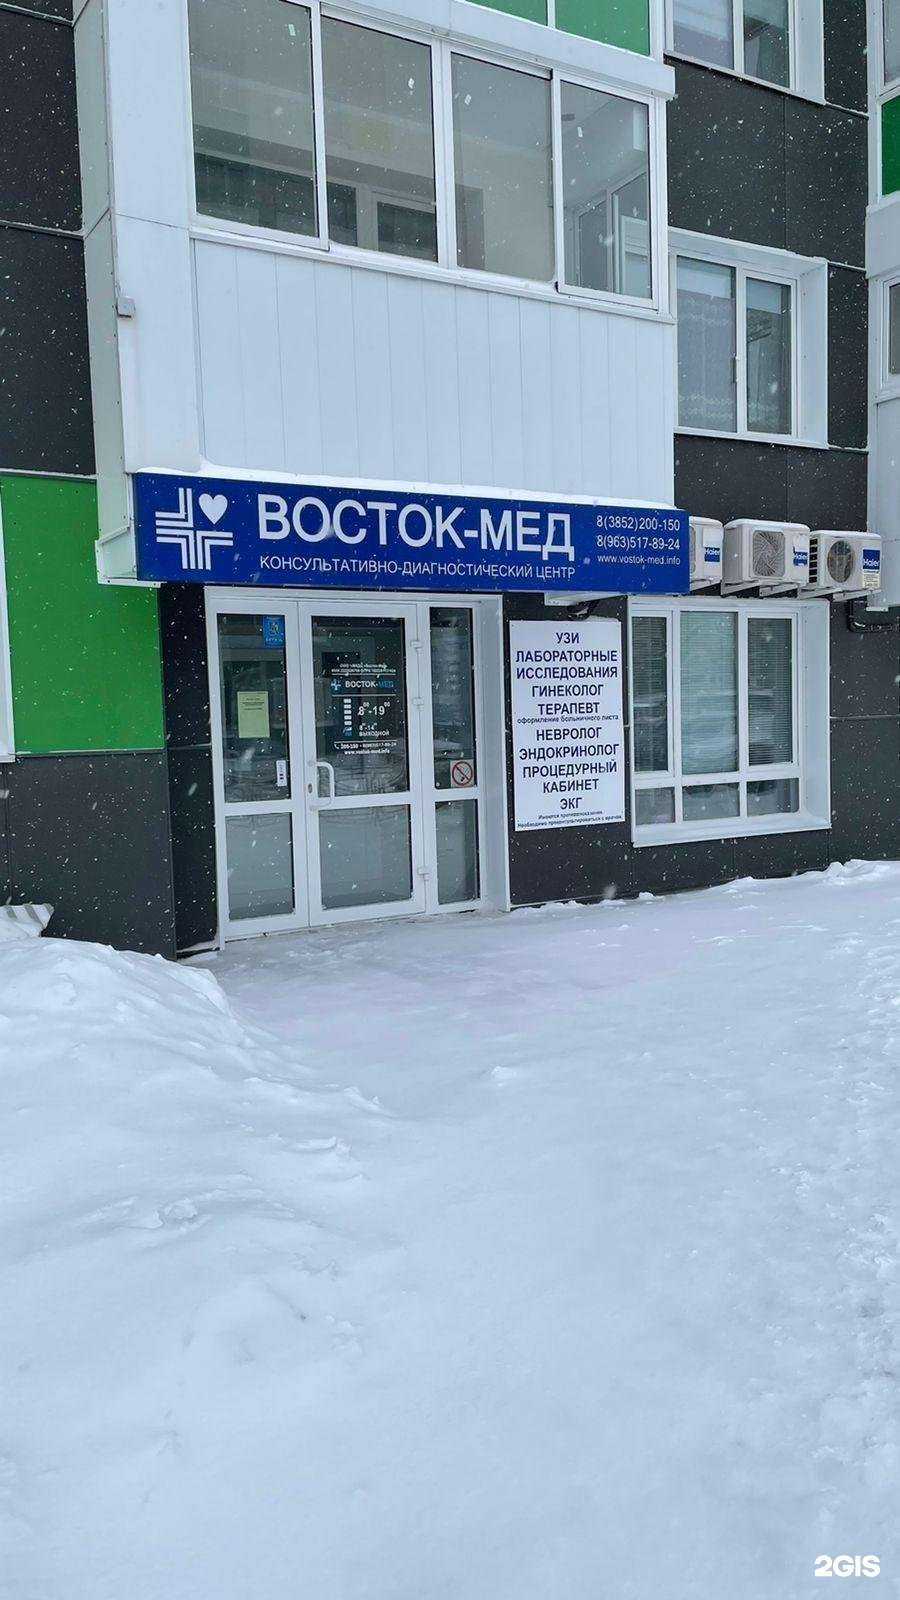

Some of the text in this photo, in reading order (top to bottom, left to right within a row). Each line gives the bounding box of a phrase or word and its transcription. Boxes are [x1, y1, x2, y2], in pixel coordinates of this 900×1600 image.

[257, 493, 575, 561] ВОСТОК-МЕД
[596, 515, 681, 532] 8(3852)200-150
[596, 536, 681, 551] 8(963)517-89-24
[597, 554, 681, 566] www.vostok-med.info
[260, 555, 576, 580] КОНСУЛЬТАТИВНО-ДИАГНОСТИЧЕСКИЙ ЦЕНТР
[555, 632, 580, 644] УЗИ
[516, 650, 618, 663] ЛАБОРАТОРНЫЕ
[516, 667, 618, 681] ИССЛЕДОВАНИЯ
[532, 684, 604, 698] ГИНЕКОЛОГ
[538, 702, 600, 716] ТЕРАПЕВТ
[536, 727, 602, 741] НЕВРОЛОГ
[519, 743, 620, 761] ЭНДОКРИНОЛОГ
[522, 759, 618, 779] ПРОЦЕДУРНЫЙ
[543, 778, 599, 794] КАБИНЕТ
[559, 797, 583, 810] ЭКГ
